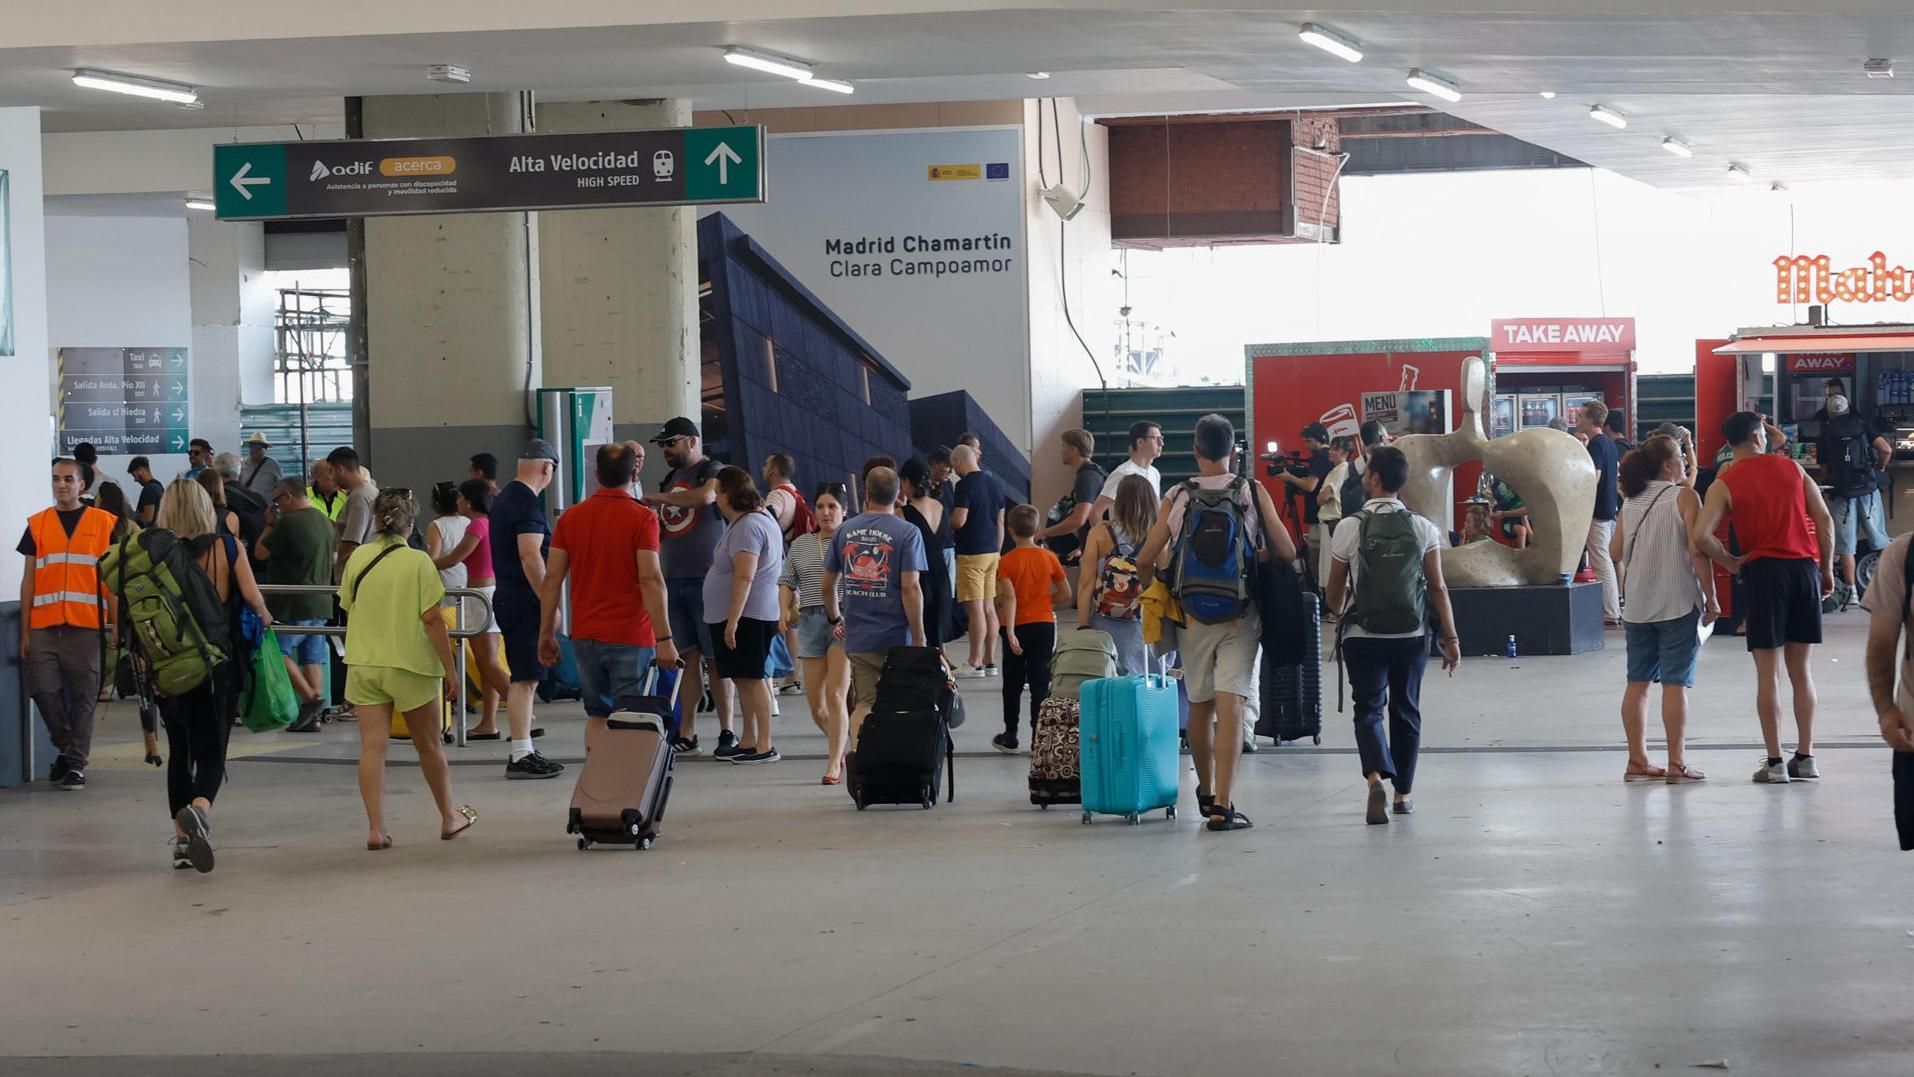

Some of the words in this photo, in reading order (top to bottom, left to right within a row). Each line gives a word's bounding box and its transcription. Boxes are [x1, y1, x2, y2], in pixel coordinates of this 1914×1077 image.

[332, 161, 374, 176] adif
[394, 159, 442, 172] acerca
[509, 155, 545, 173] Alta
[550, 150, 639, 171] Velocidad
[367, 182, 399, 190] personas
[413, 180, 457, 189] discapacidad
[577, 176, 604, 188] HIGH
[607, 175, 640, 187] SPEED
[427, 186, 457, 194] reducida
[825, 236, 895, 255] Madrid
[903, 233, 1012, 253] Chamartín
[830, 260, 882, 278] Clara
[890, 258, 1012, 278] Campoamor
[1772, 251, 1914, 304] Mah
[1503, 324, 1561, 344] TAKE
[1563, 324, 1625, 343] AWAY
[129, 353, 145, 361] Taxi
[1794, 357, 1845, 369] AWAY
[74, 381, 97, 390] Salida
[1365, 394, 1397, 412] MENU
[88, 408, 111, 416] Salida
[104, 435, 120, 444] Alta
[121, 434, 160, 444] Velocidad
